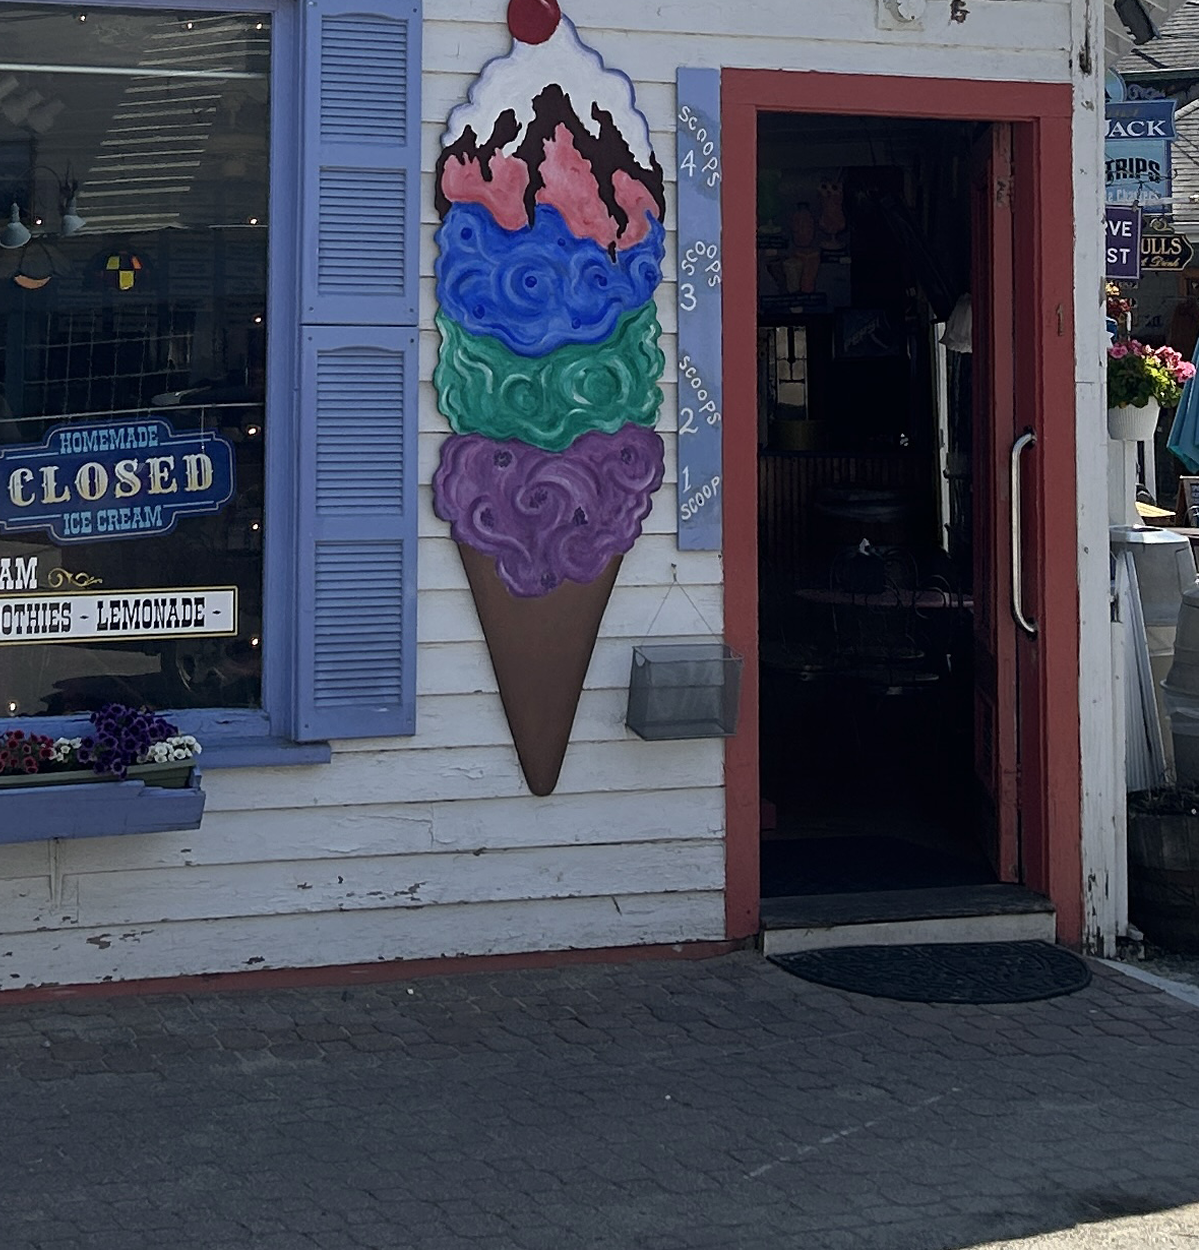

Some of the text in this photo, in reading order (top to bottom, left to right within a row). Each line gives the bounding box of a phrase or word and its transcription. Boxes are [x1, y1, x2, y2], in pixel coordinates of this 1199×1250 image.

[678, 105, 719, 187] SCOOPS
[680, 149, 696, 177] 4
[681, 241, 721, 287] SCOOPS
[1107, 247, 1131, 265] ST
[680, 283, 696, 311] 3
[679, 355, 721, 425] SCOOPS
[679, 407, 699, 434] 2
[59, 425, 159, 454] HOMEMADE
[8, 452, 214, 507] CLOSED
[682, 465, 691, 493] 1
[680, 476, 720, 520] SCOOP
[63, 505, 163, 535] ICE CREAM
[96, 597, 205, 632] LEMONADE
